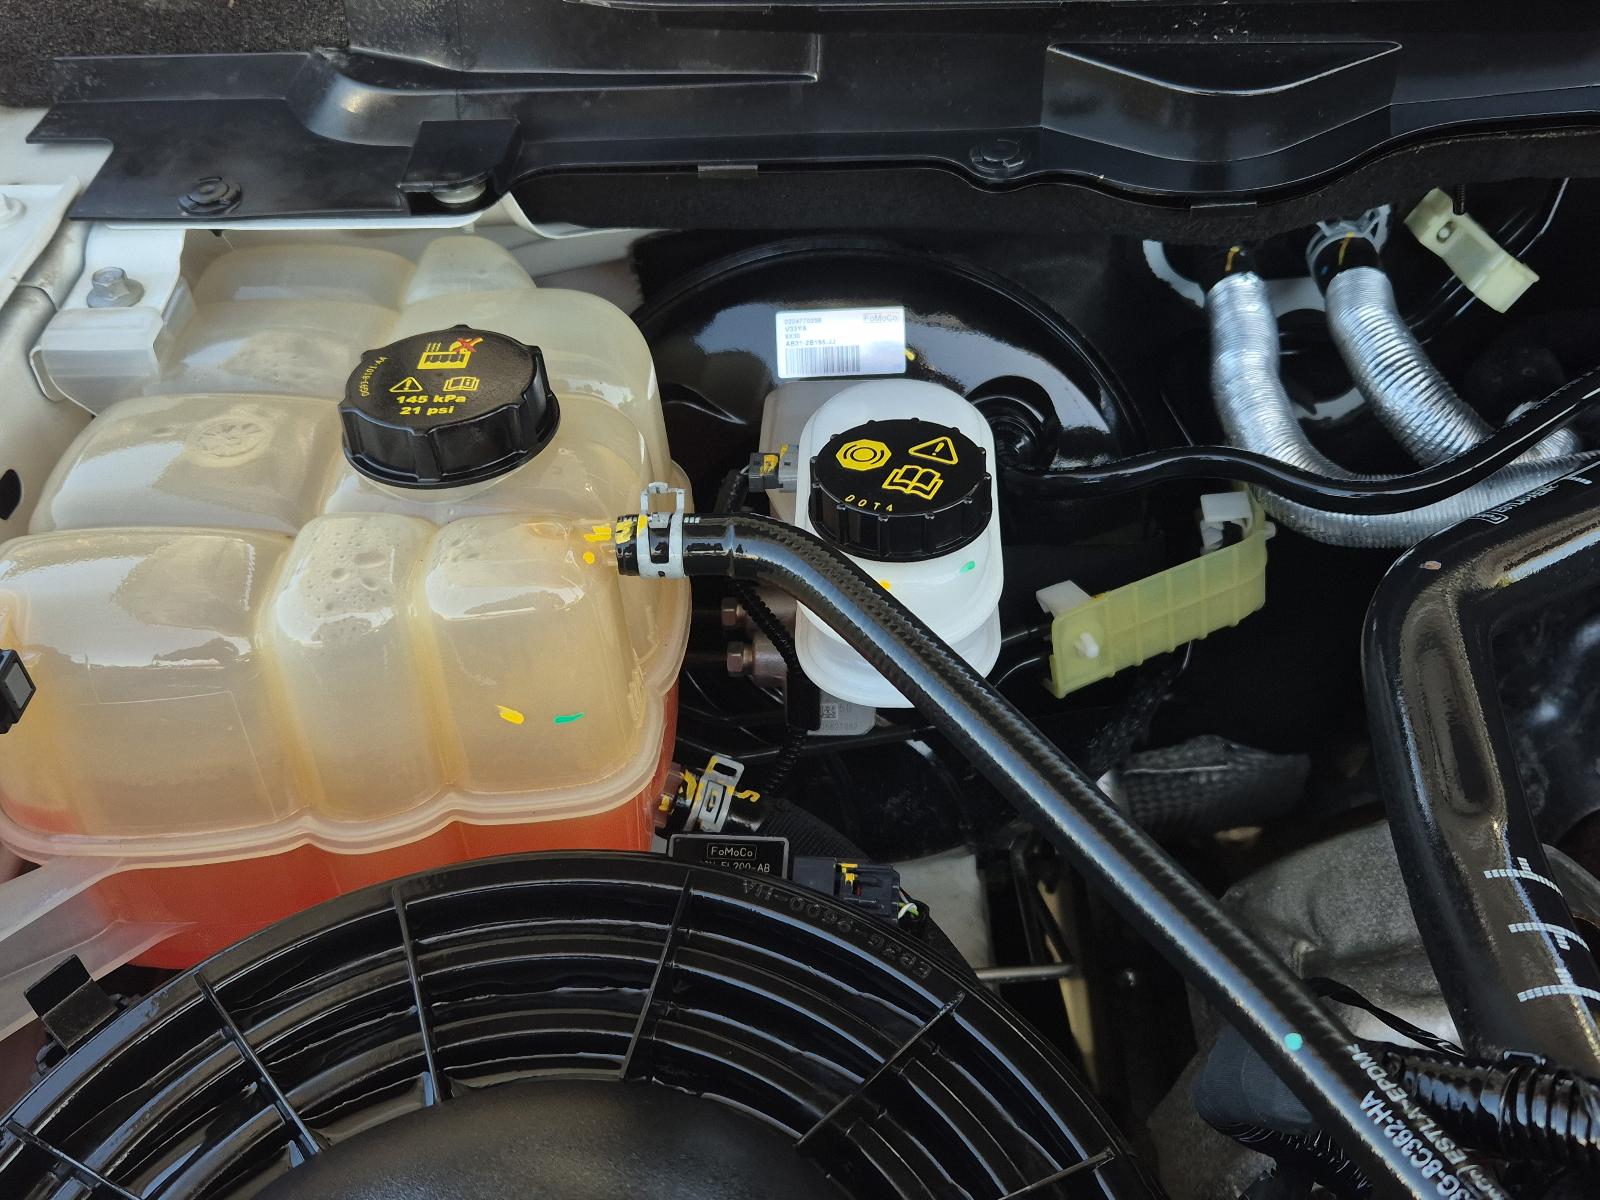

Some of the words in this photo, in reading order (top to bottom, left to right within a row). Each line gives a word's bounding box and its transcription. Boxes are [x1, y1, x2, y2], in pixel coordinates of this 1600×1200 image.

[396, 395, 429, 404] 145
[433, 394, 467, 403] kPa
[399, 406, 421, 415] 21
[426, 406, 455, 415] psi
[711, 846, 753, 857] FoMoCo
